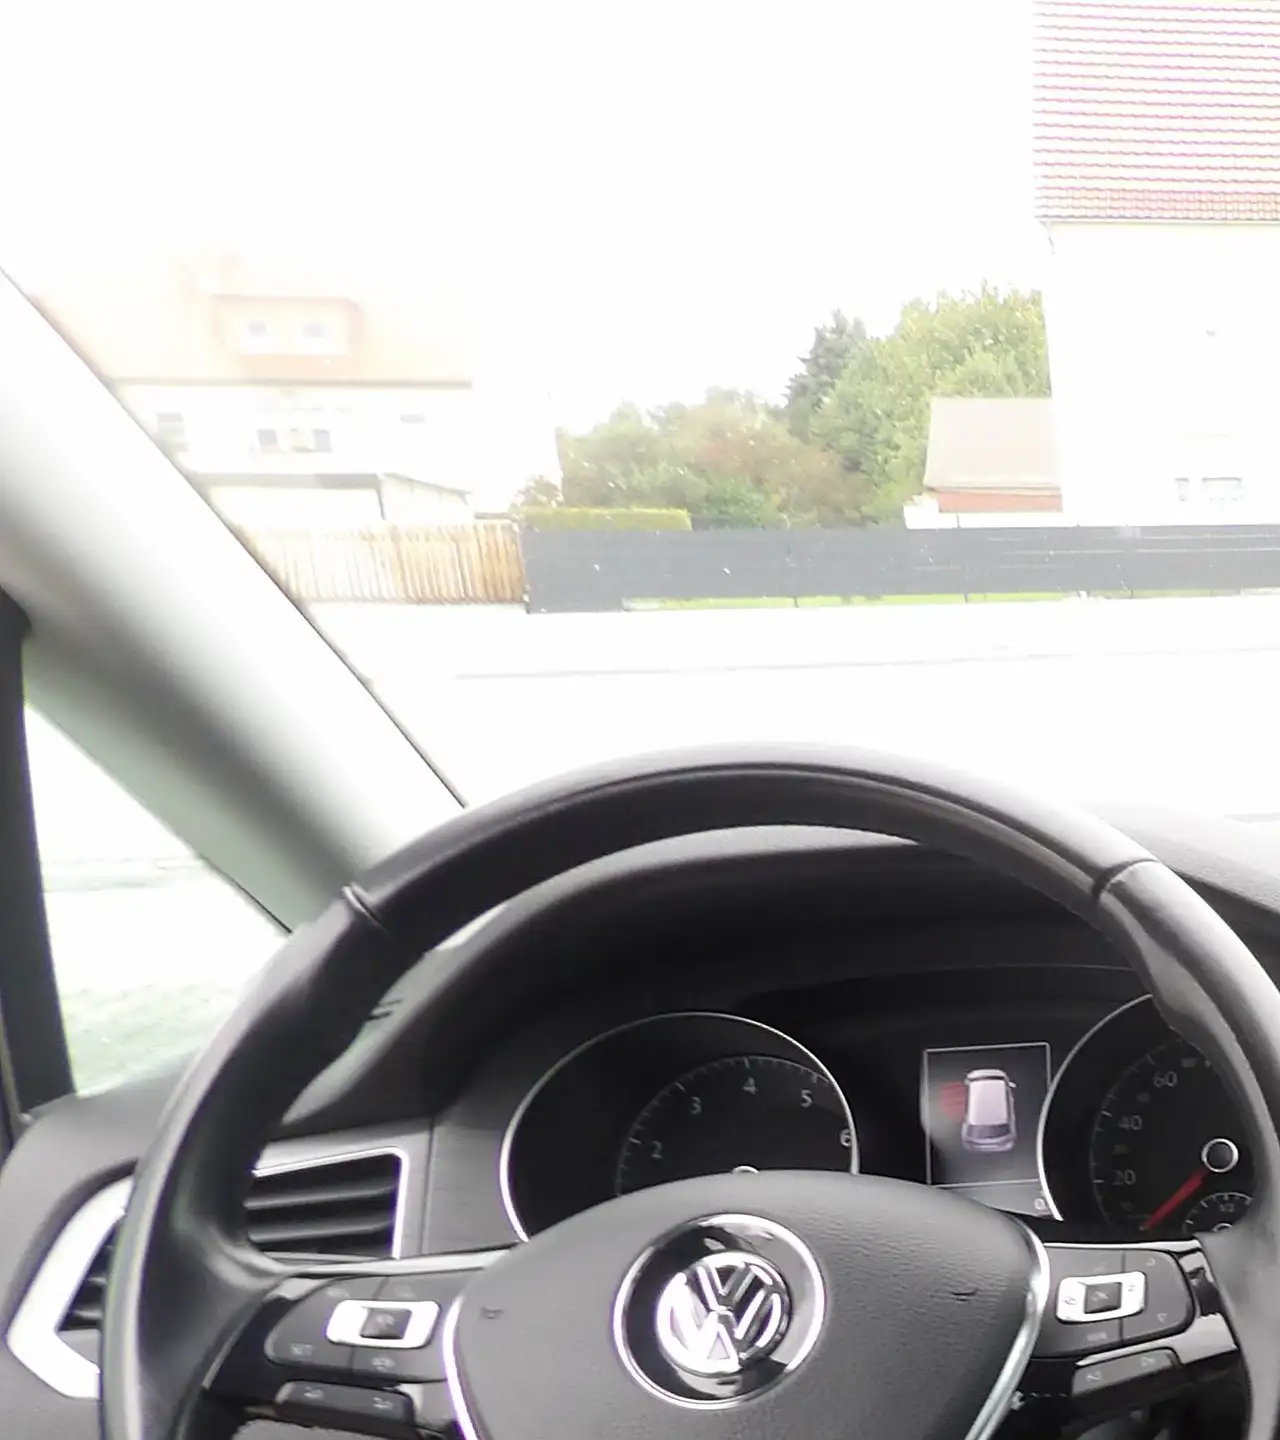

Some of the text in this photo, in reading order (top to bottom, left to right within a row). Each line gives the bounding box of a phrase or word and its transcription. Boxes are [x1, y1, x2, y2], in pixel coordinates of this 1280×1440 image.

[742, 1076, 757, 1095] 4
[1153, 1070, 1178, 1088] 60
[690, 1097, 702, 1115] 3
[800, 1089, 813, 1107] 5
[1118, 1115, 1143, 1131] 40
[651, 1141, 662, 1159] 2
[1112, 1169, 1136, 1186] 20
